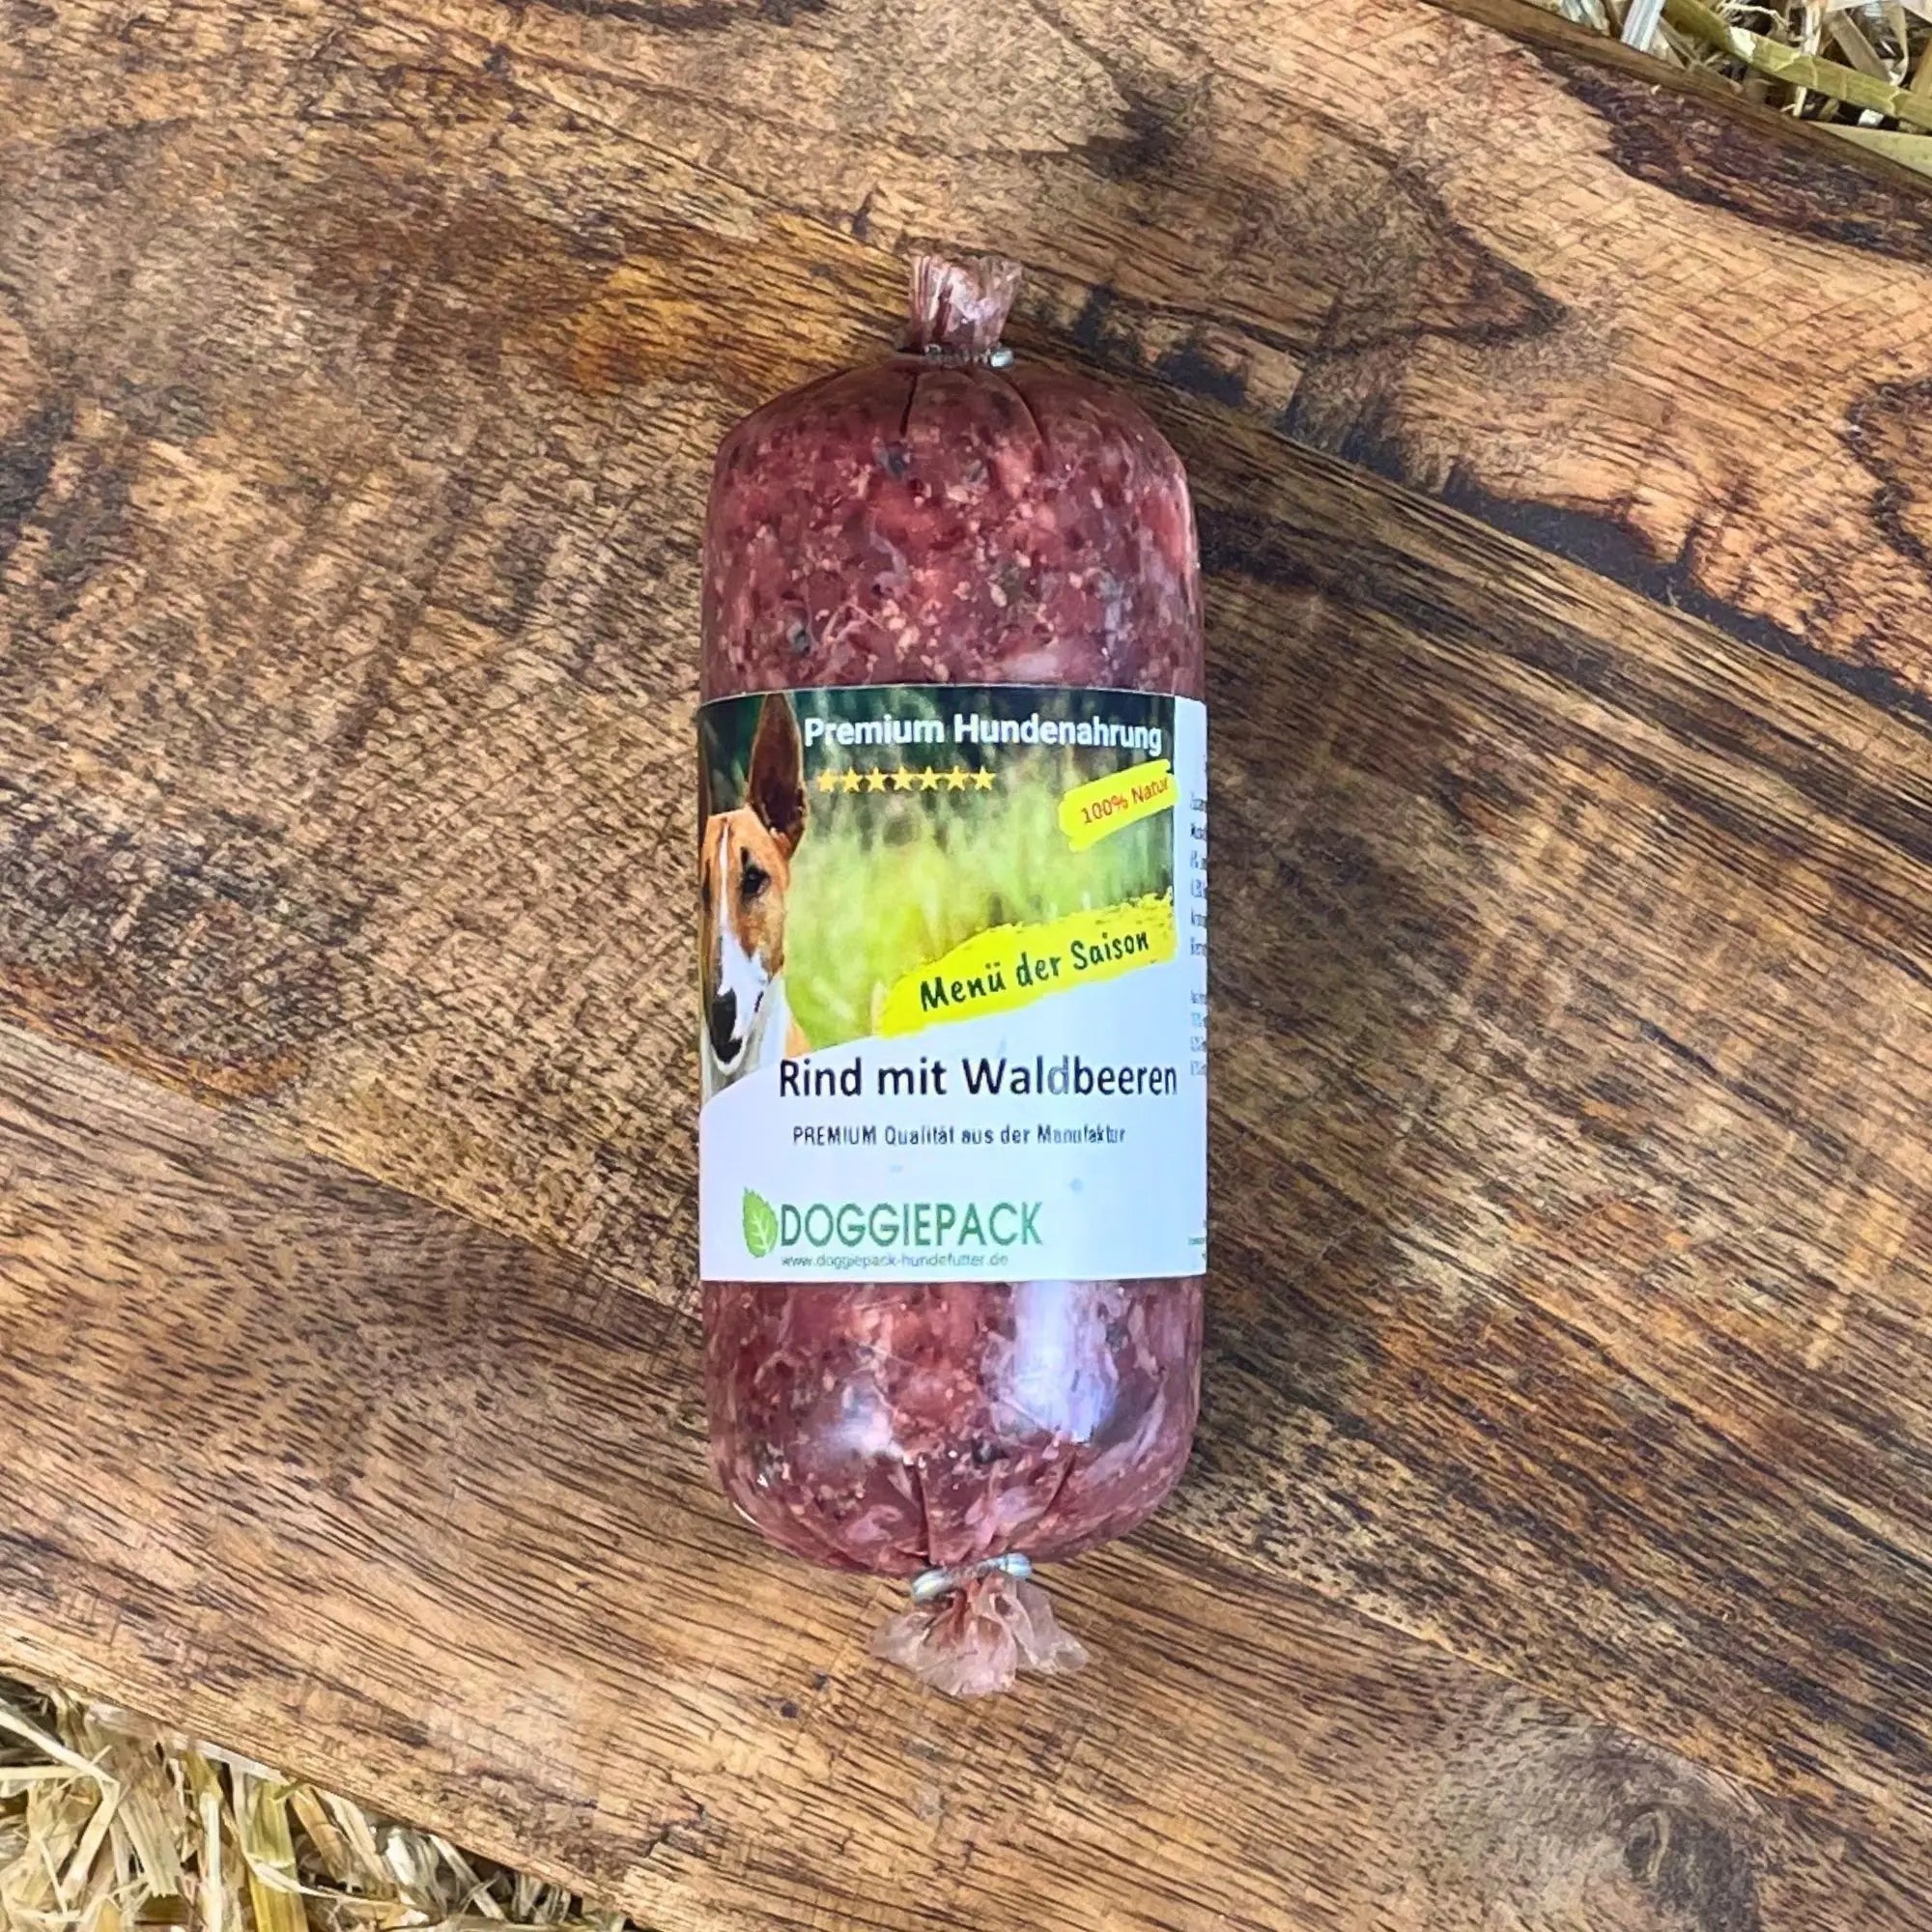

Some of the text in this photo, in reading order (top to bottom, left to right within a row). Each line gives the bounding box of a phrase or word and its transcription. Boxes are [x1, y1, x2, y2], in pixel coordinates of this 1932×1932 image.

[804, 713, 1163, 755] Premium Hundenahrung
[1080, 794, 1129, 825] 100%
[1131, 777, 1171, 806] Natur
[920, 961, 1008, 1012] Menü
[1016, 952, 1062, 986] der
[1071, 928, 1150, 970] Saison
[780, 1057, 862, 1097] Rind
[878, 1058, 947, 1096] mit
[962, 1056, 1179, 1096] Waldbeeren
[793, 1124, 1126, 1148] PREMIUM Qualität aus der Manufaktur
[780, 1202, 1043, 1247] DOGGIEPACK
[781, 1252, 1009, 1270] www.doggiepack-hundefutter.de
